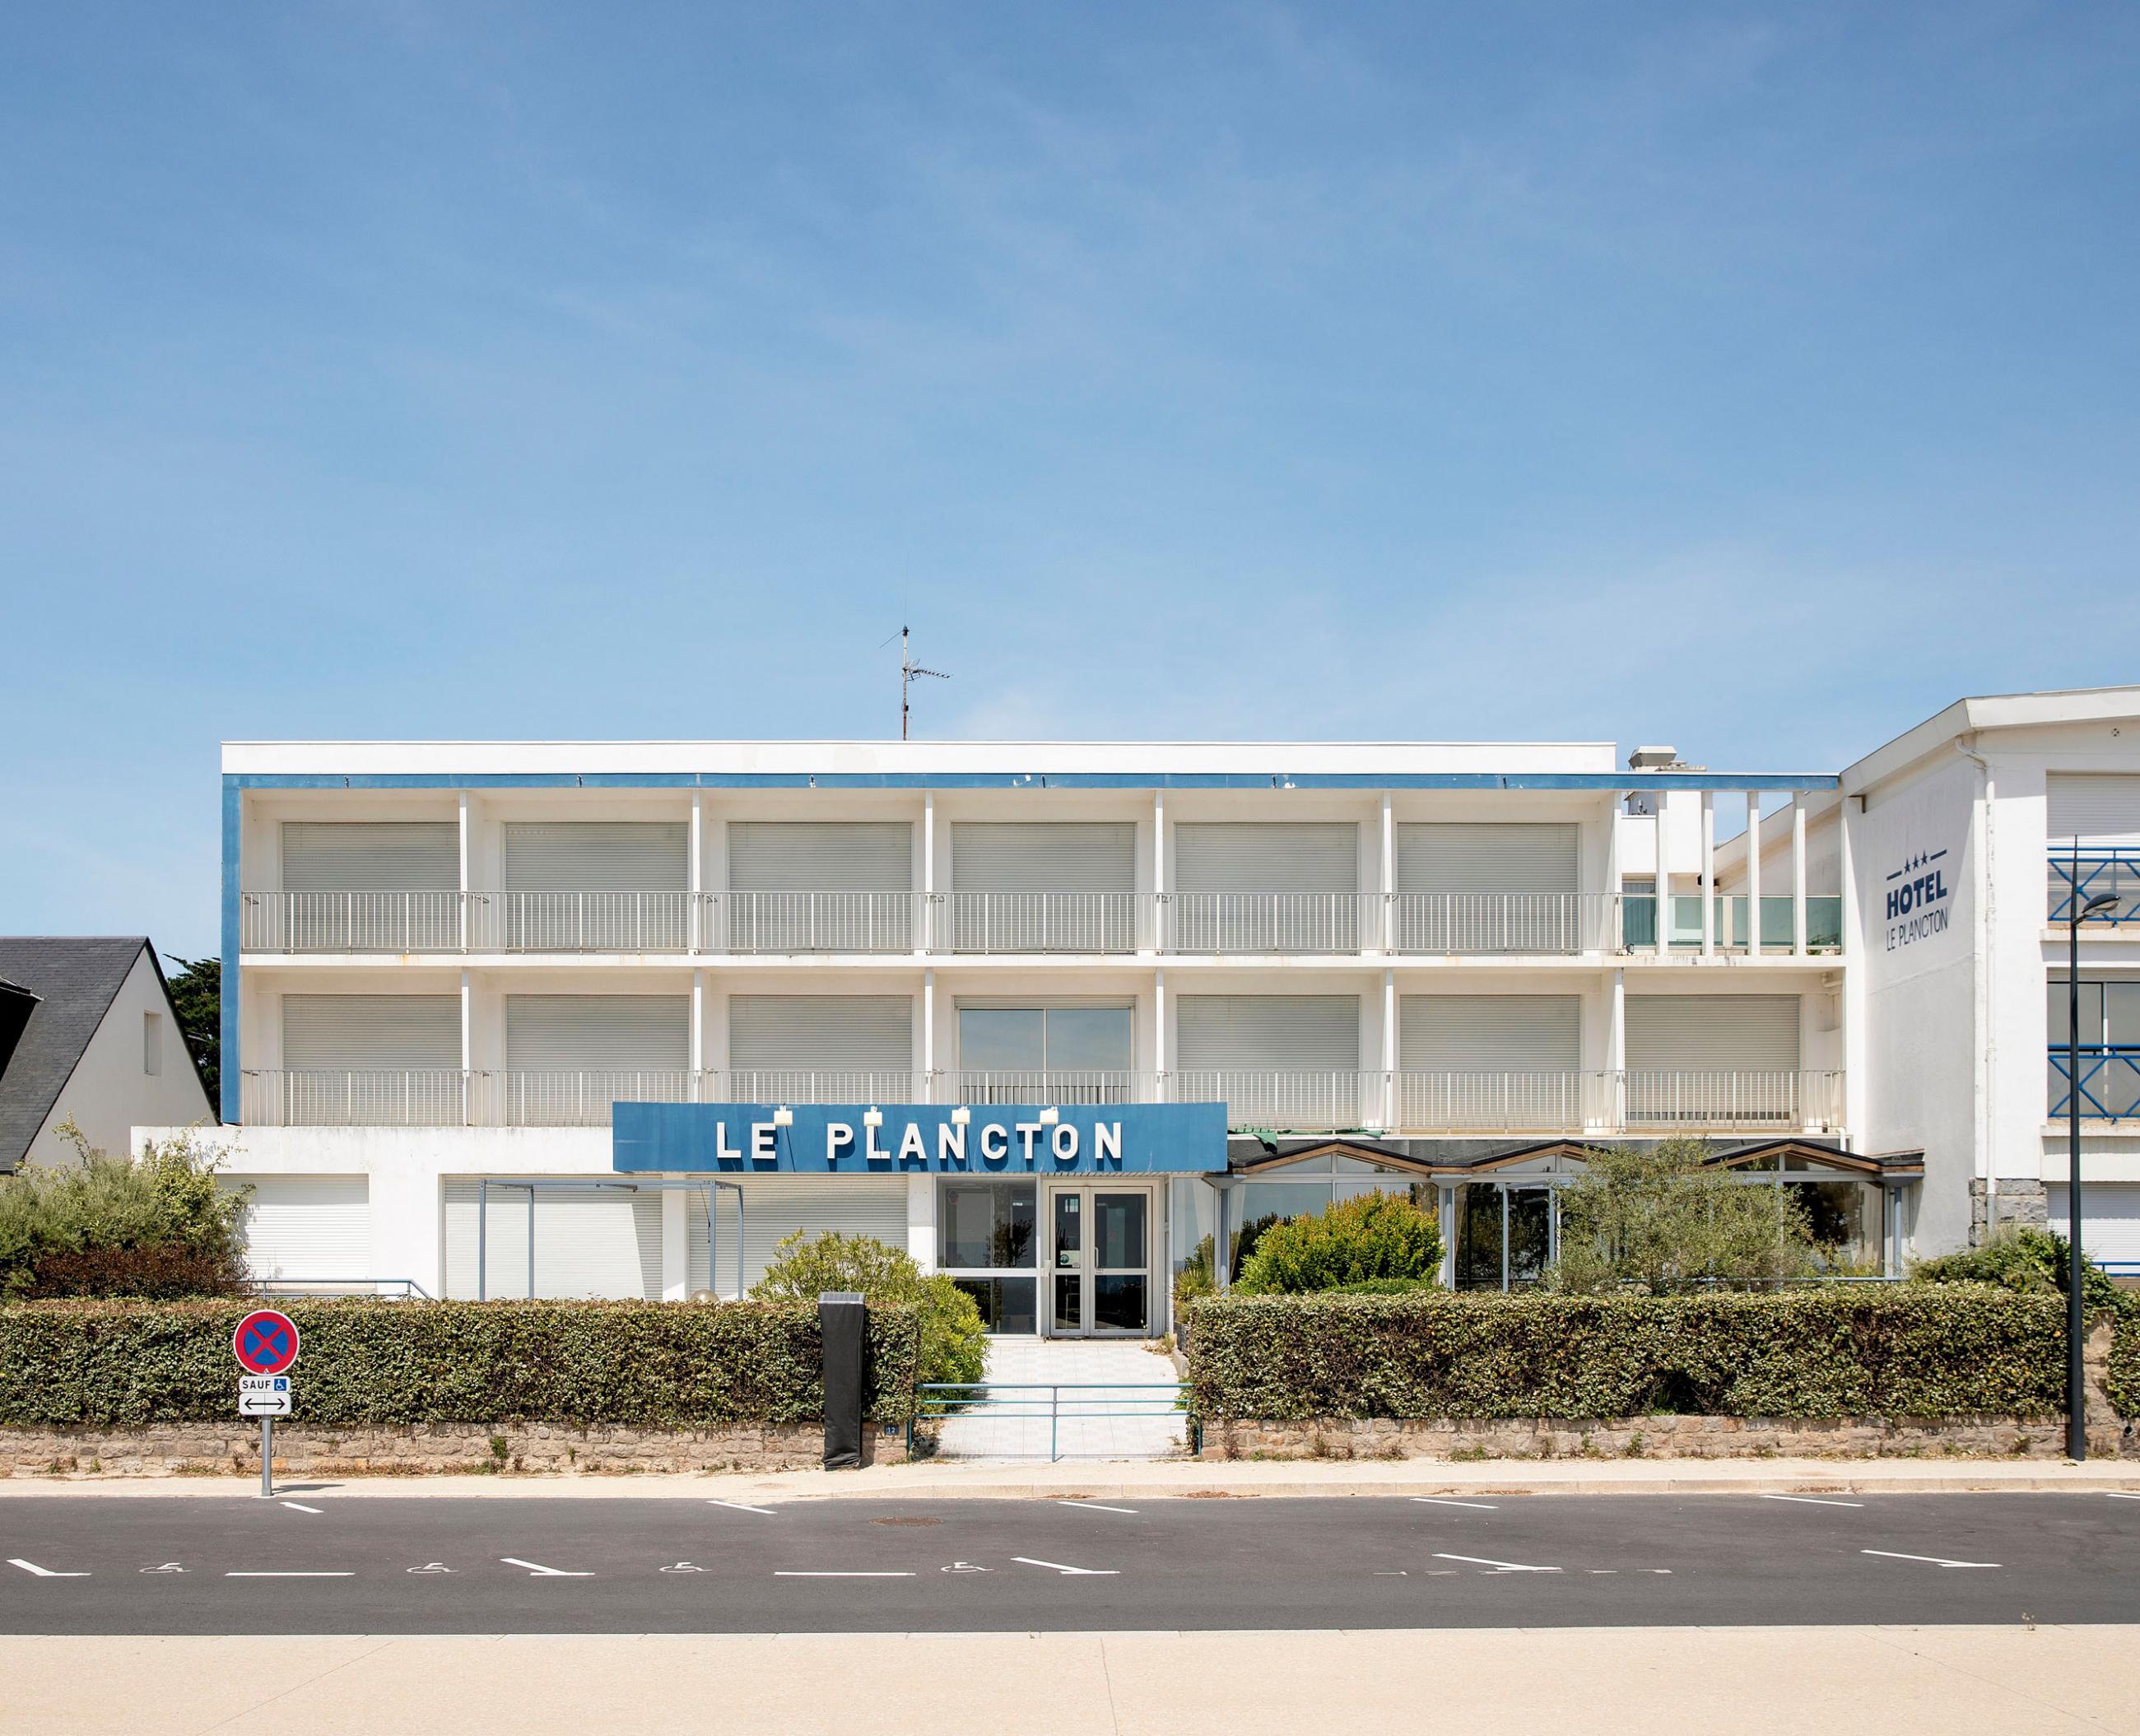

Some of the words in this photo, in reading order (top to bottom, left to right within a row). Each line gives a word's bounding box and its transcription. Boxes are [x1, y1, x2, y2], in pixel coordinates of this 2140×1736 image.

[1886, 869, 1947, 920] HOTEL
[1886, 928, 1896, 952] LE
[1899, 906, 1948, 947] PLANCTON
[717, 1122, 776, 1160] LE
[827, 1122, 1122, 1160] PLANCTON
[242, 1380, 271, 1389] SAUF
